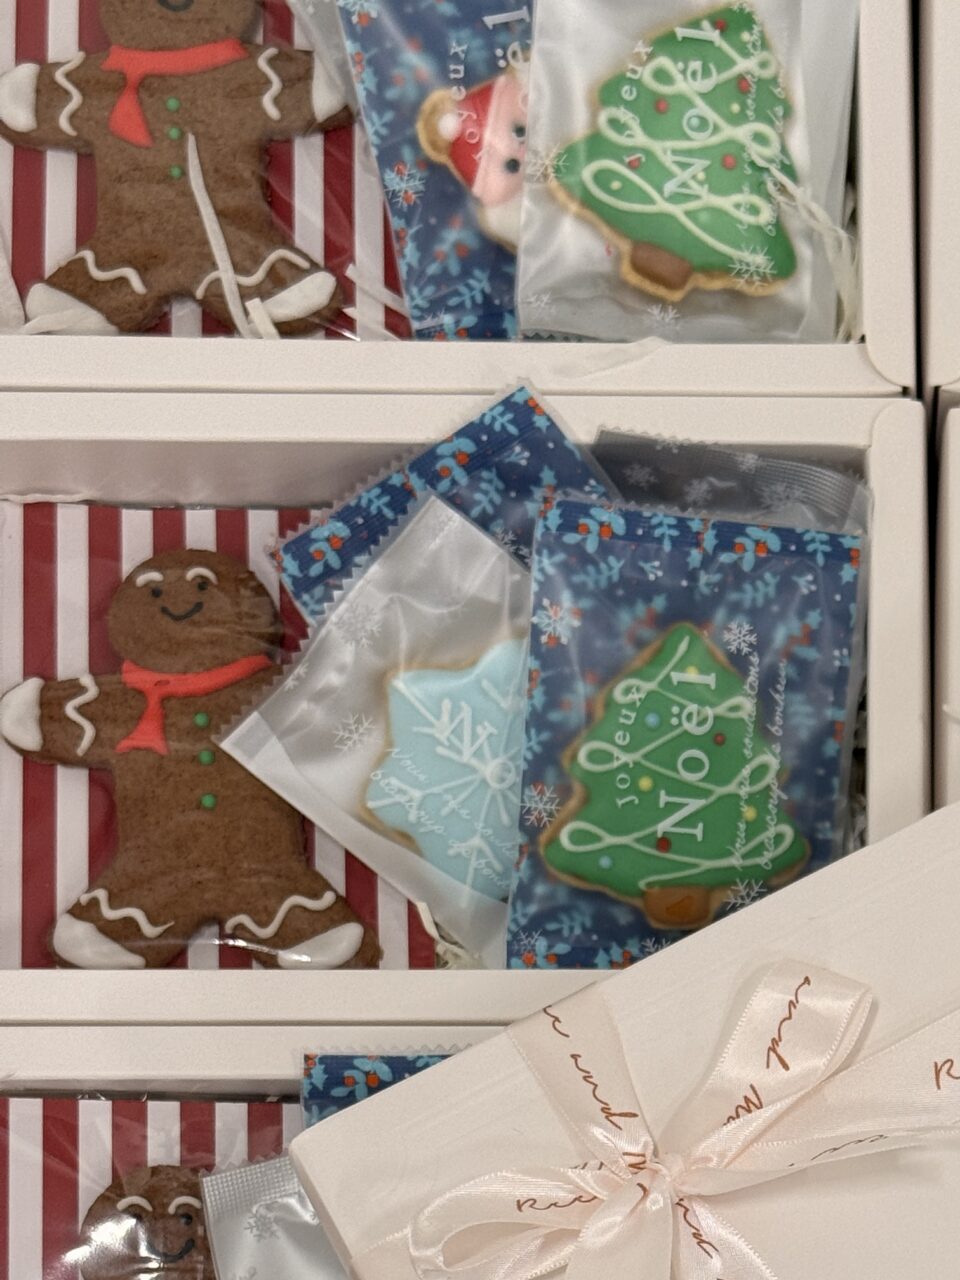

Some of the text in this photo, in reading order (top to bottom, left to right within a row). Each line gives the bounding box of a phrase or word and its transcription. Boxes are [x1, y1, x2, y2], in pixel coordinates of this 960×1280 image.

[614, 685, 648, 809] Joyeux
[657, 671, 717, 842] Noël
[569, 1053, 639, 1131] and
